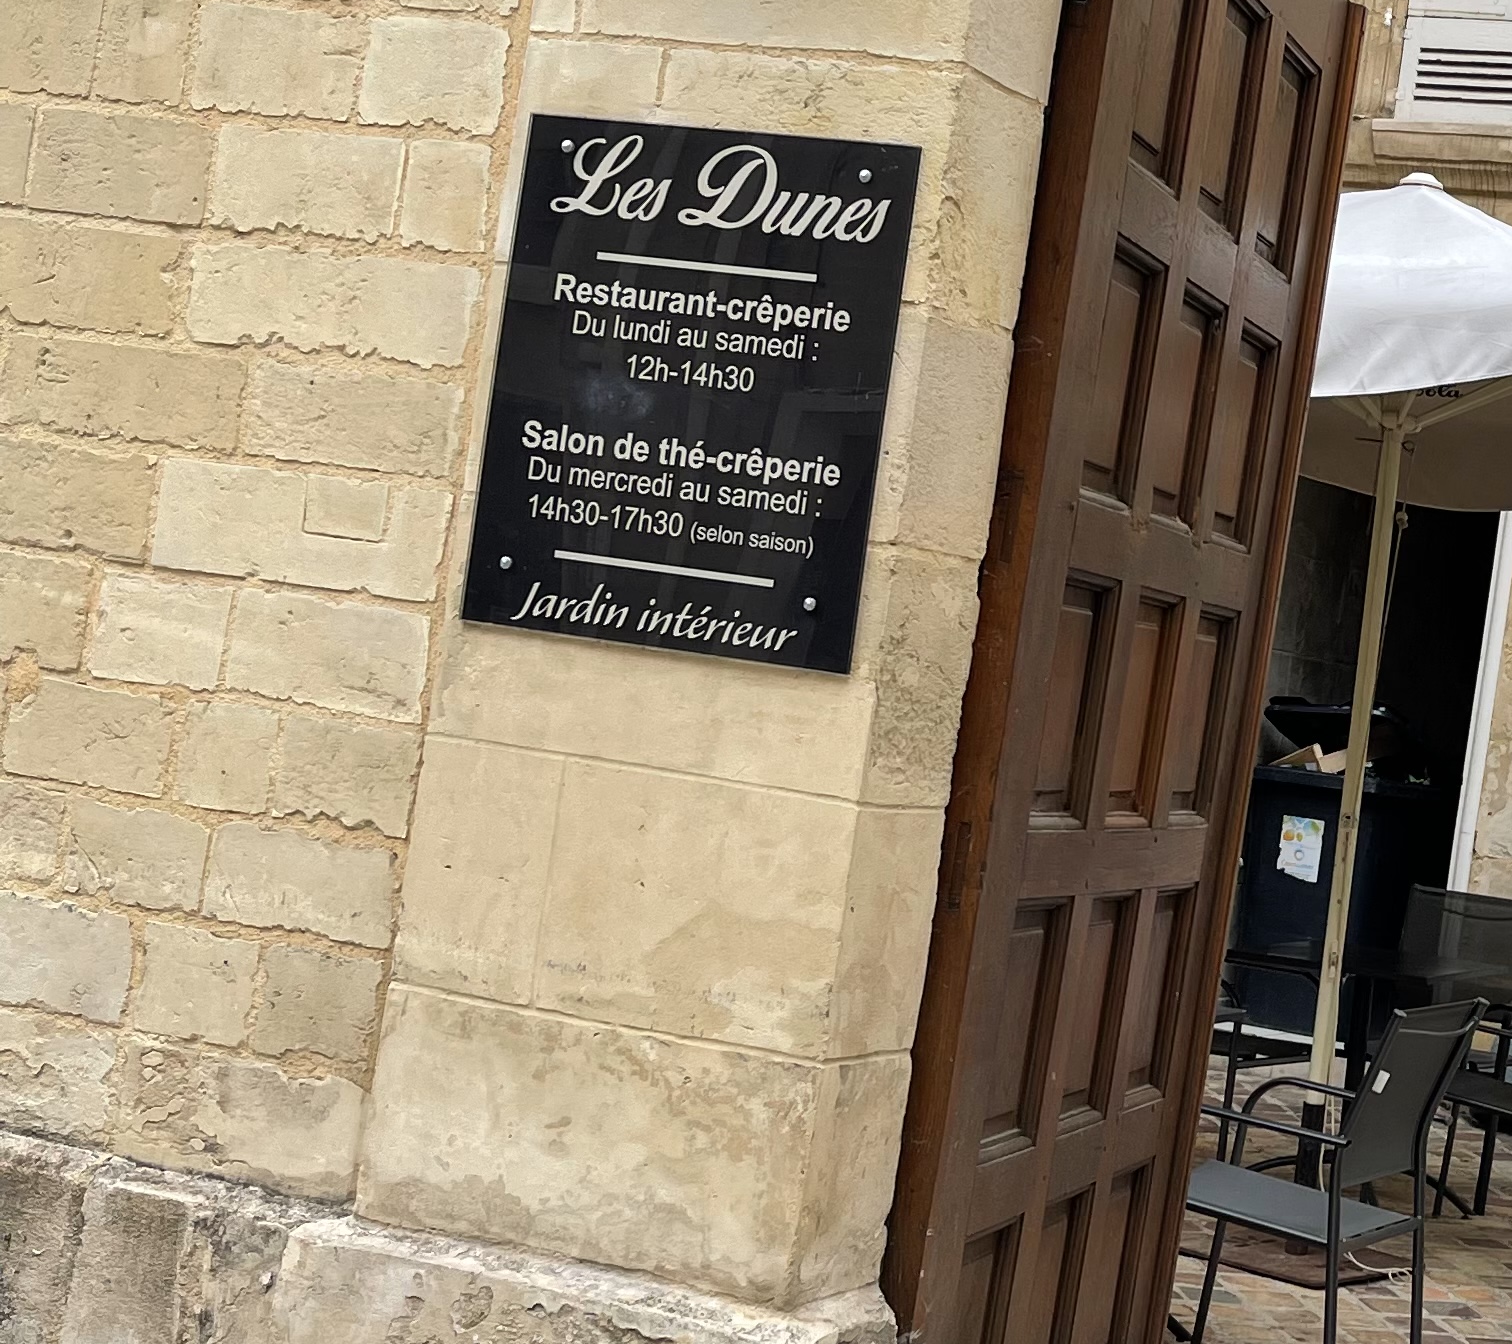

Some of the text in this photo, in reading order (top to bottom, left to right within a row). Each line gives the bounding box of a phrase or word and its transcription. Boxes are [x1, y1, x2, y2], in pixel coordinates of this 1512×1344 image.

[550, 135, 891, 242] Les Dunes
[554, 272, 851, 332] Restaurant-crêperie
[572, 309, 607, 337] Du
[612, 314, 671, 345] lundi
[676, 327, 708, 349] au
[714, 331, 805, 360] samedi
[627, 354, 755, 392] 12h-14h30
[521, 419, 841, 487] Salon de thé-crêperie
[527, 455, 562, 483] Du
[568, 467, 673, 499] mercredi
[679, 481, 711, 503] au
[717, 486, 808, 515] samedi
[528, 493, 814, 559] 14h30-17h30 (selon saison)
[510, 582, 798, 651] Jardin intérieur
